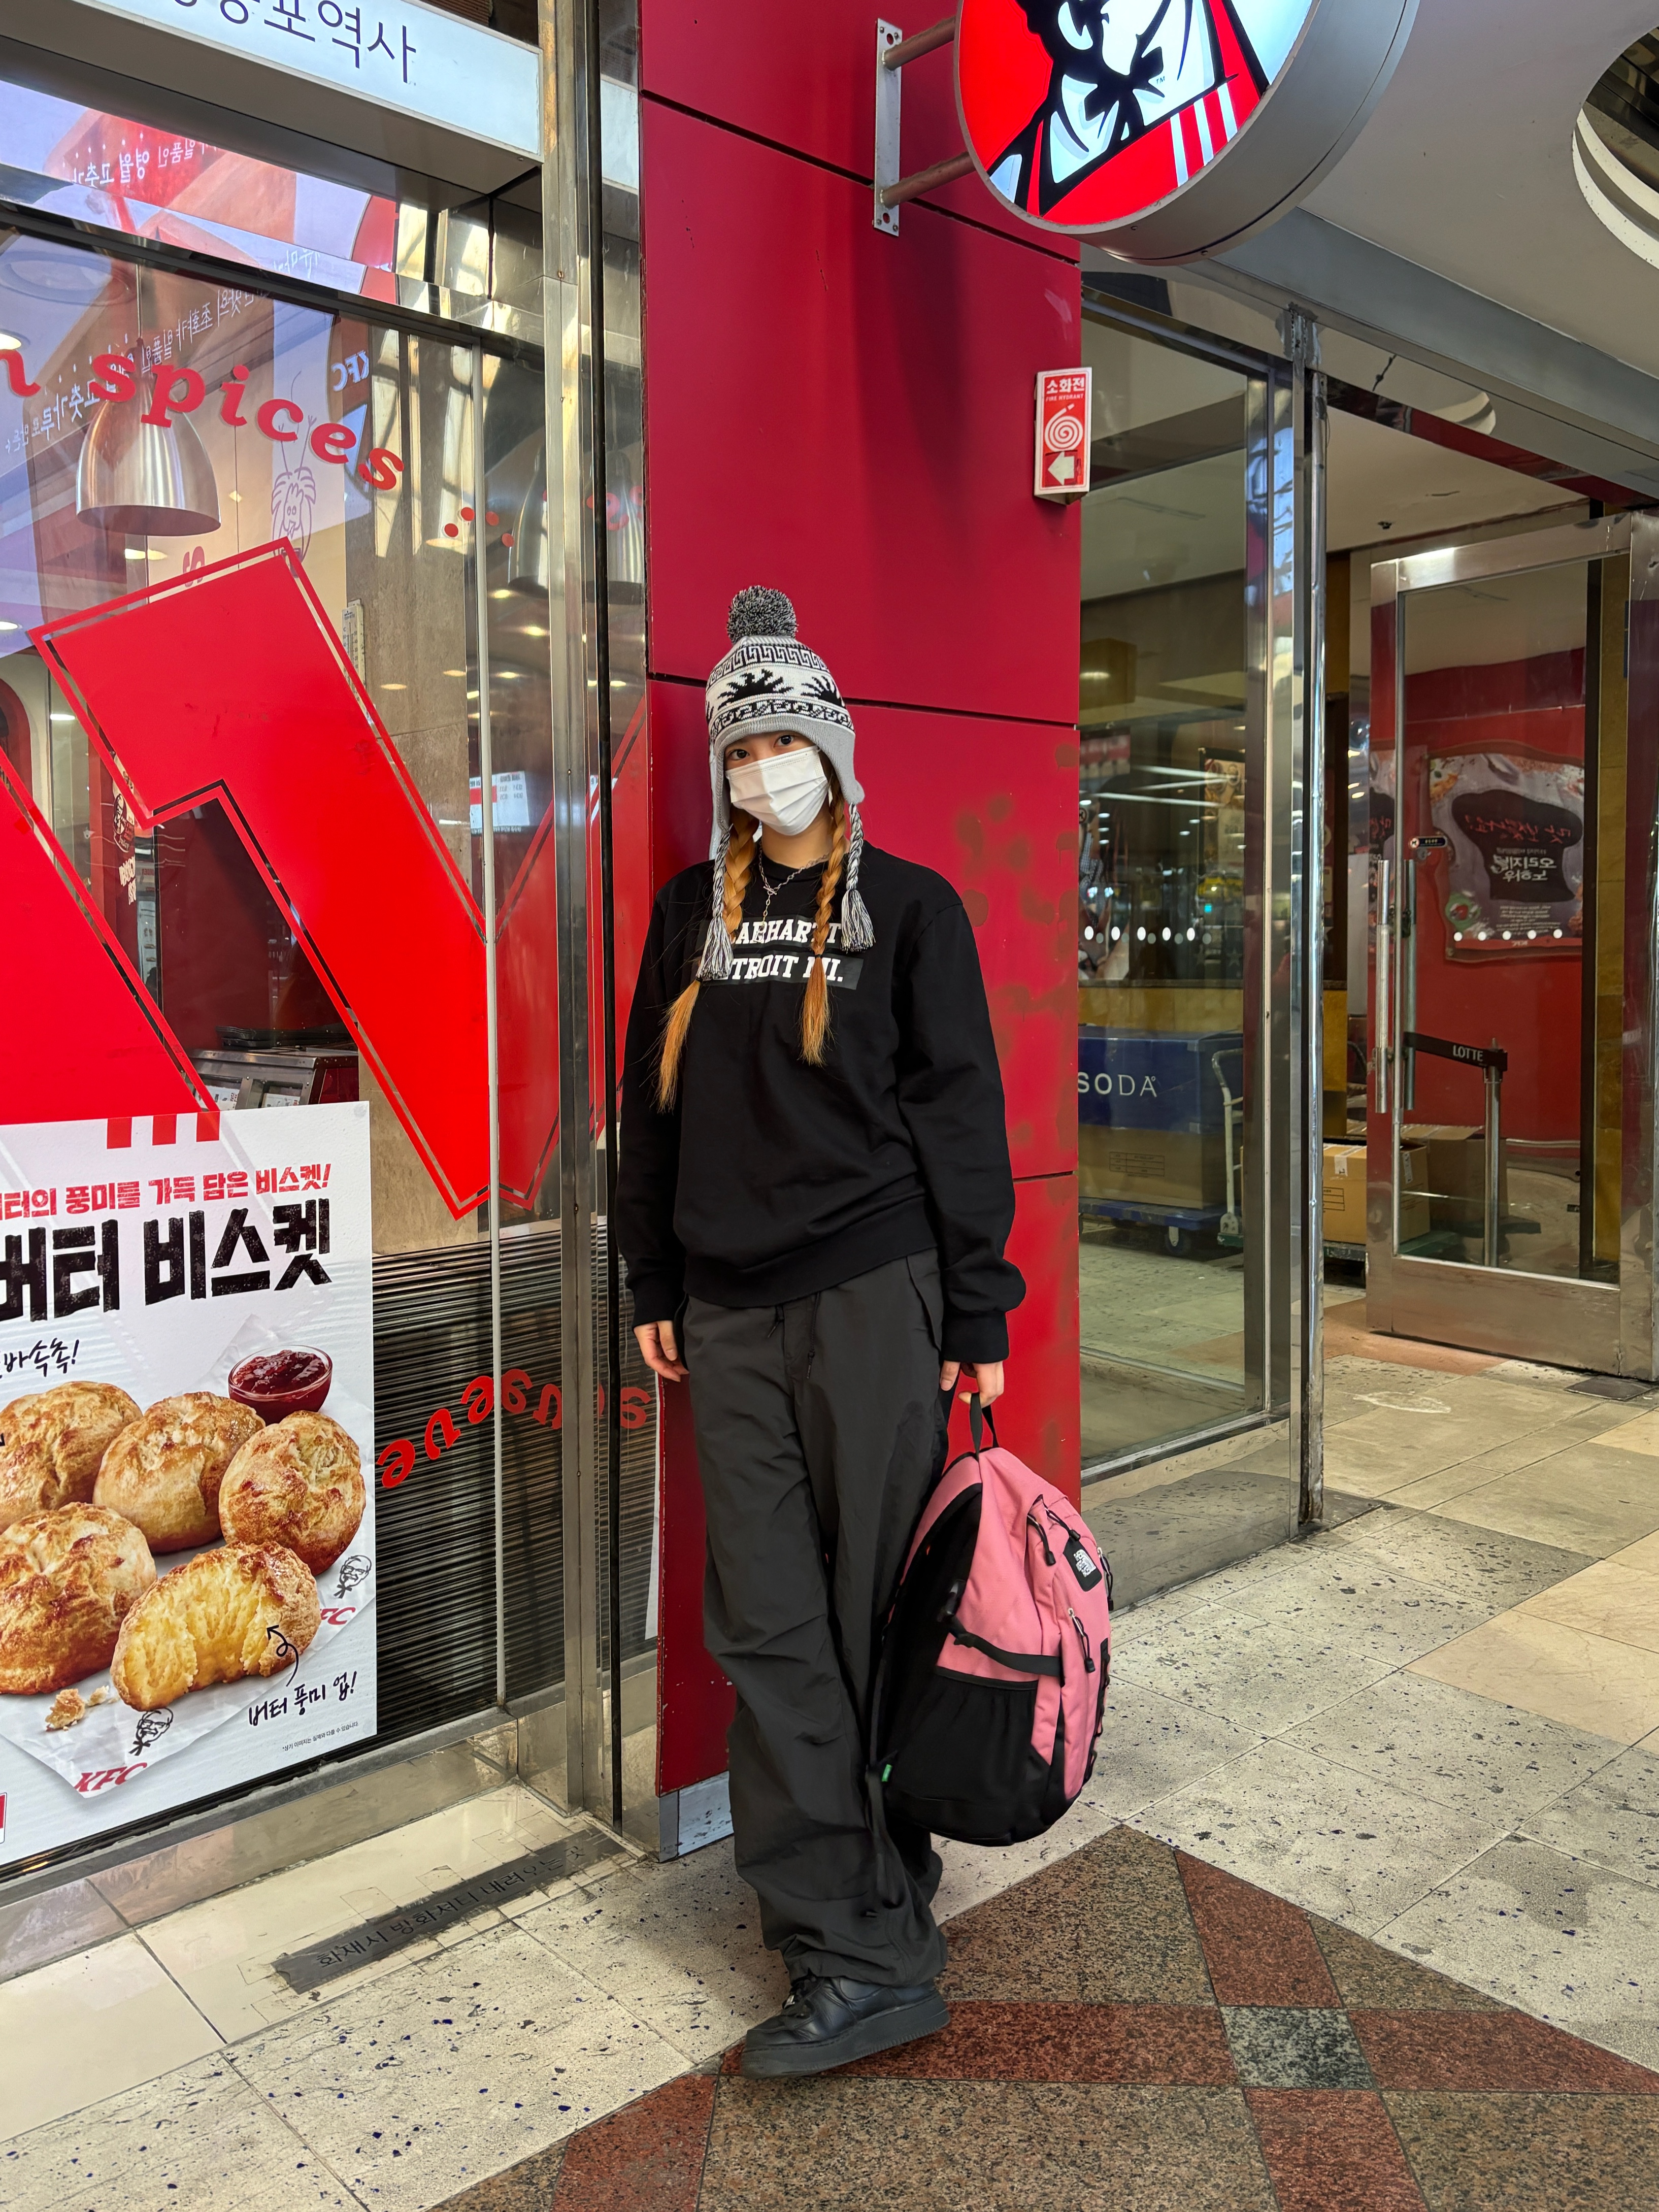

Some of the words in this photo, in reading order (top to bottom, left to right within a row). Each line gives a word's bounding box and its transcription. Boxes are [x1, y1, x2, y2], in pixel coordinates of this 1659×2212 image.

[174, 0, 417, 83] 포역사
[1046, 377, 1085, 394] 소화전
[89, 353, 404, 490] spices
[1453, 1044, 1483, 1062] LOTTE
[0, 1188, 57, 1220] 터의
[65, 1181, 141, 1214] 풍미를
[148, 1176, 196, 1205] 가득
[203, 1171, 249, 1201] 담은
[255, 1163, 331, 1195] 비스켓!
[143, 1198, 333, 1306] 비스켓
[0, 1337, 80, 1378] 바속촉!
[319, 1607, 356, 1626] FC
[249, 1697, 287, 1726] 버터
[294, 1683, 326, 1715] 풍미
[333, 1671, 357, 1701] 업!
[75, 1762, 148, 1793] KFC
[316, 1930, 388, 1969] 화재시
[482, 1857, 565, 1895] 내려오는
